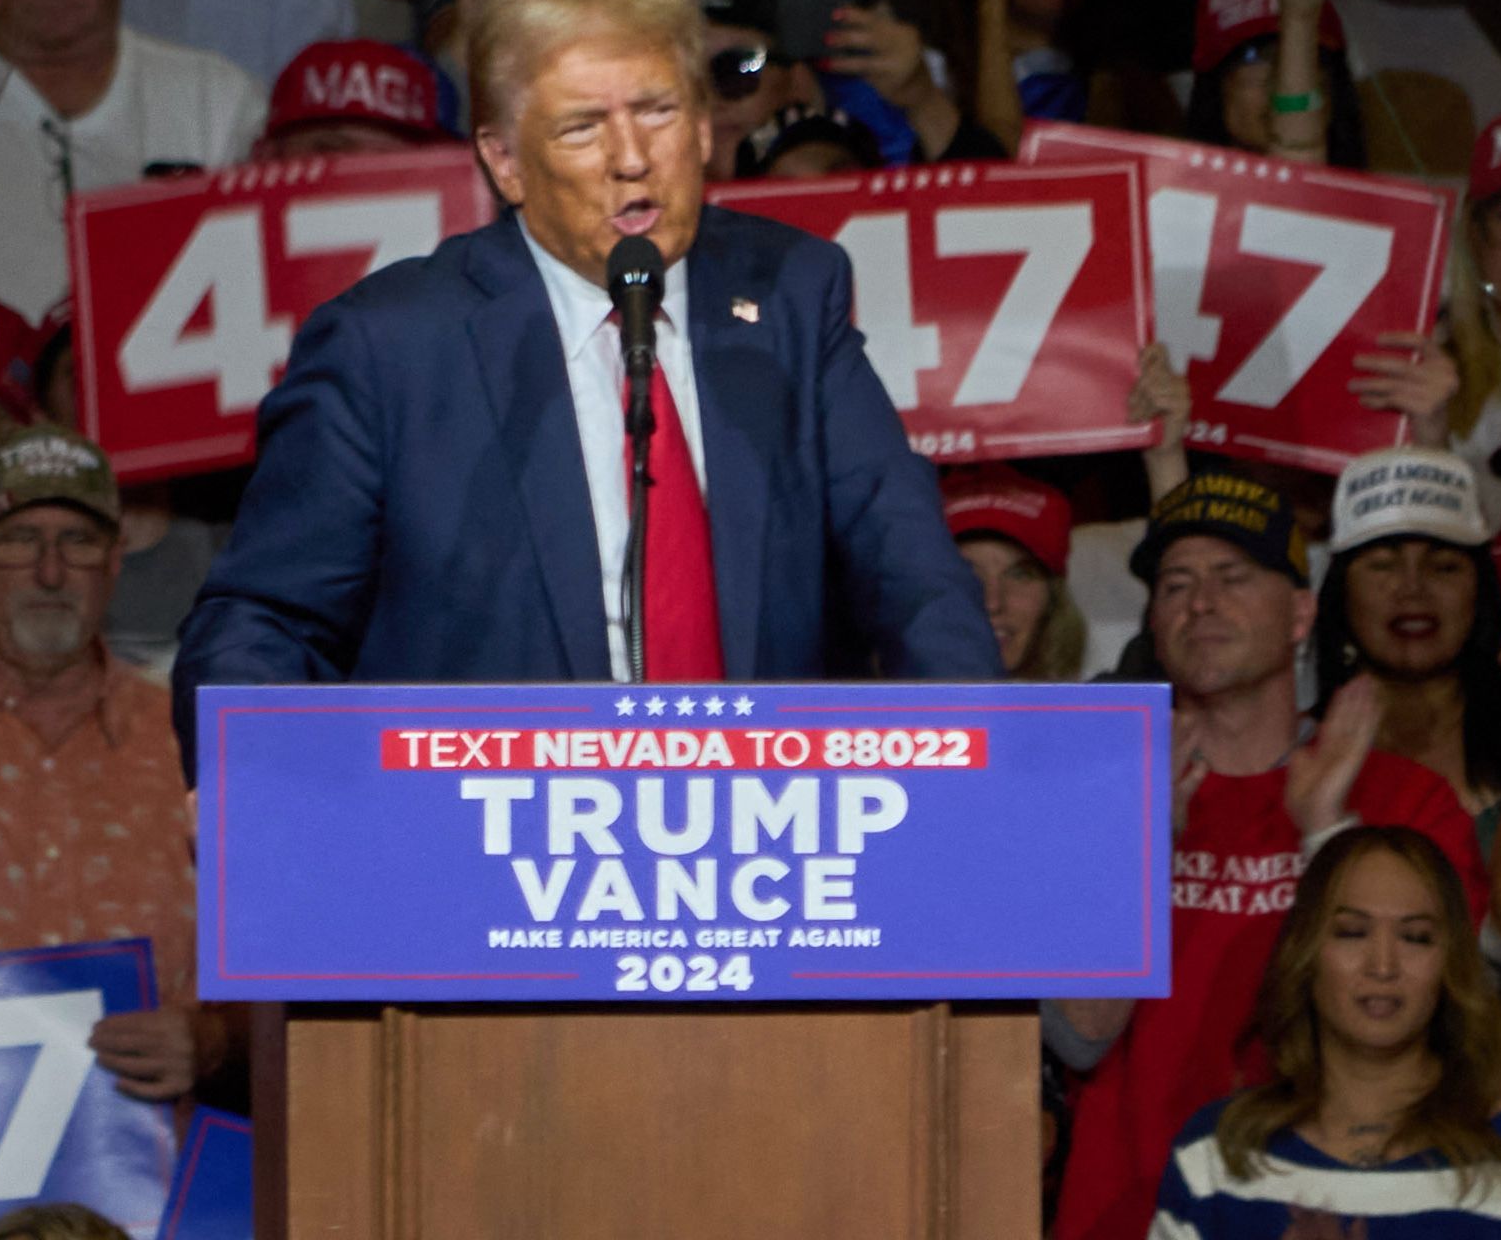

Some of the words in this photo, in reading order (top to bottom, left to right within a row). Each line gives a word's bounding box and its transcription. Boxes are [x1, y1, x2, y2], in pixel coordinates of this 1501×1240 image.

[400, 731, 521, 768] TEXT
[534, 730, 734, 768] NEVADA
[746, 731, 811, 768] TO
[824, 730, 972, 768] 88022
[460, 777, 910, 857] TRUMP
[511, 858, 857, 922] VANCE
[489, 928, 563, 949] MAKE
[569, 928, 688, 949] AMERICA
[696, 928, 783, 949] GREAT
[789, 927, 882, 949] AGAIN!
[615, 954, 754, 992] 2024
